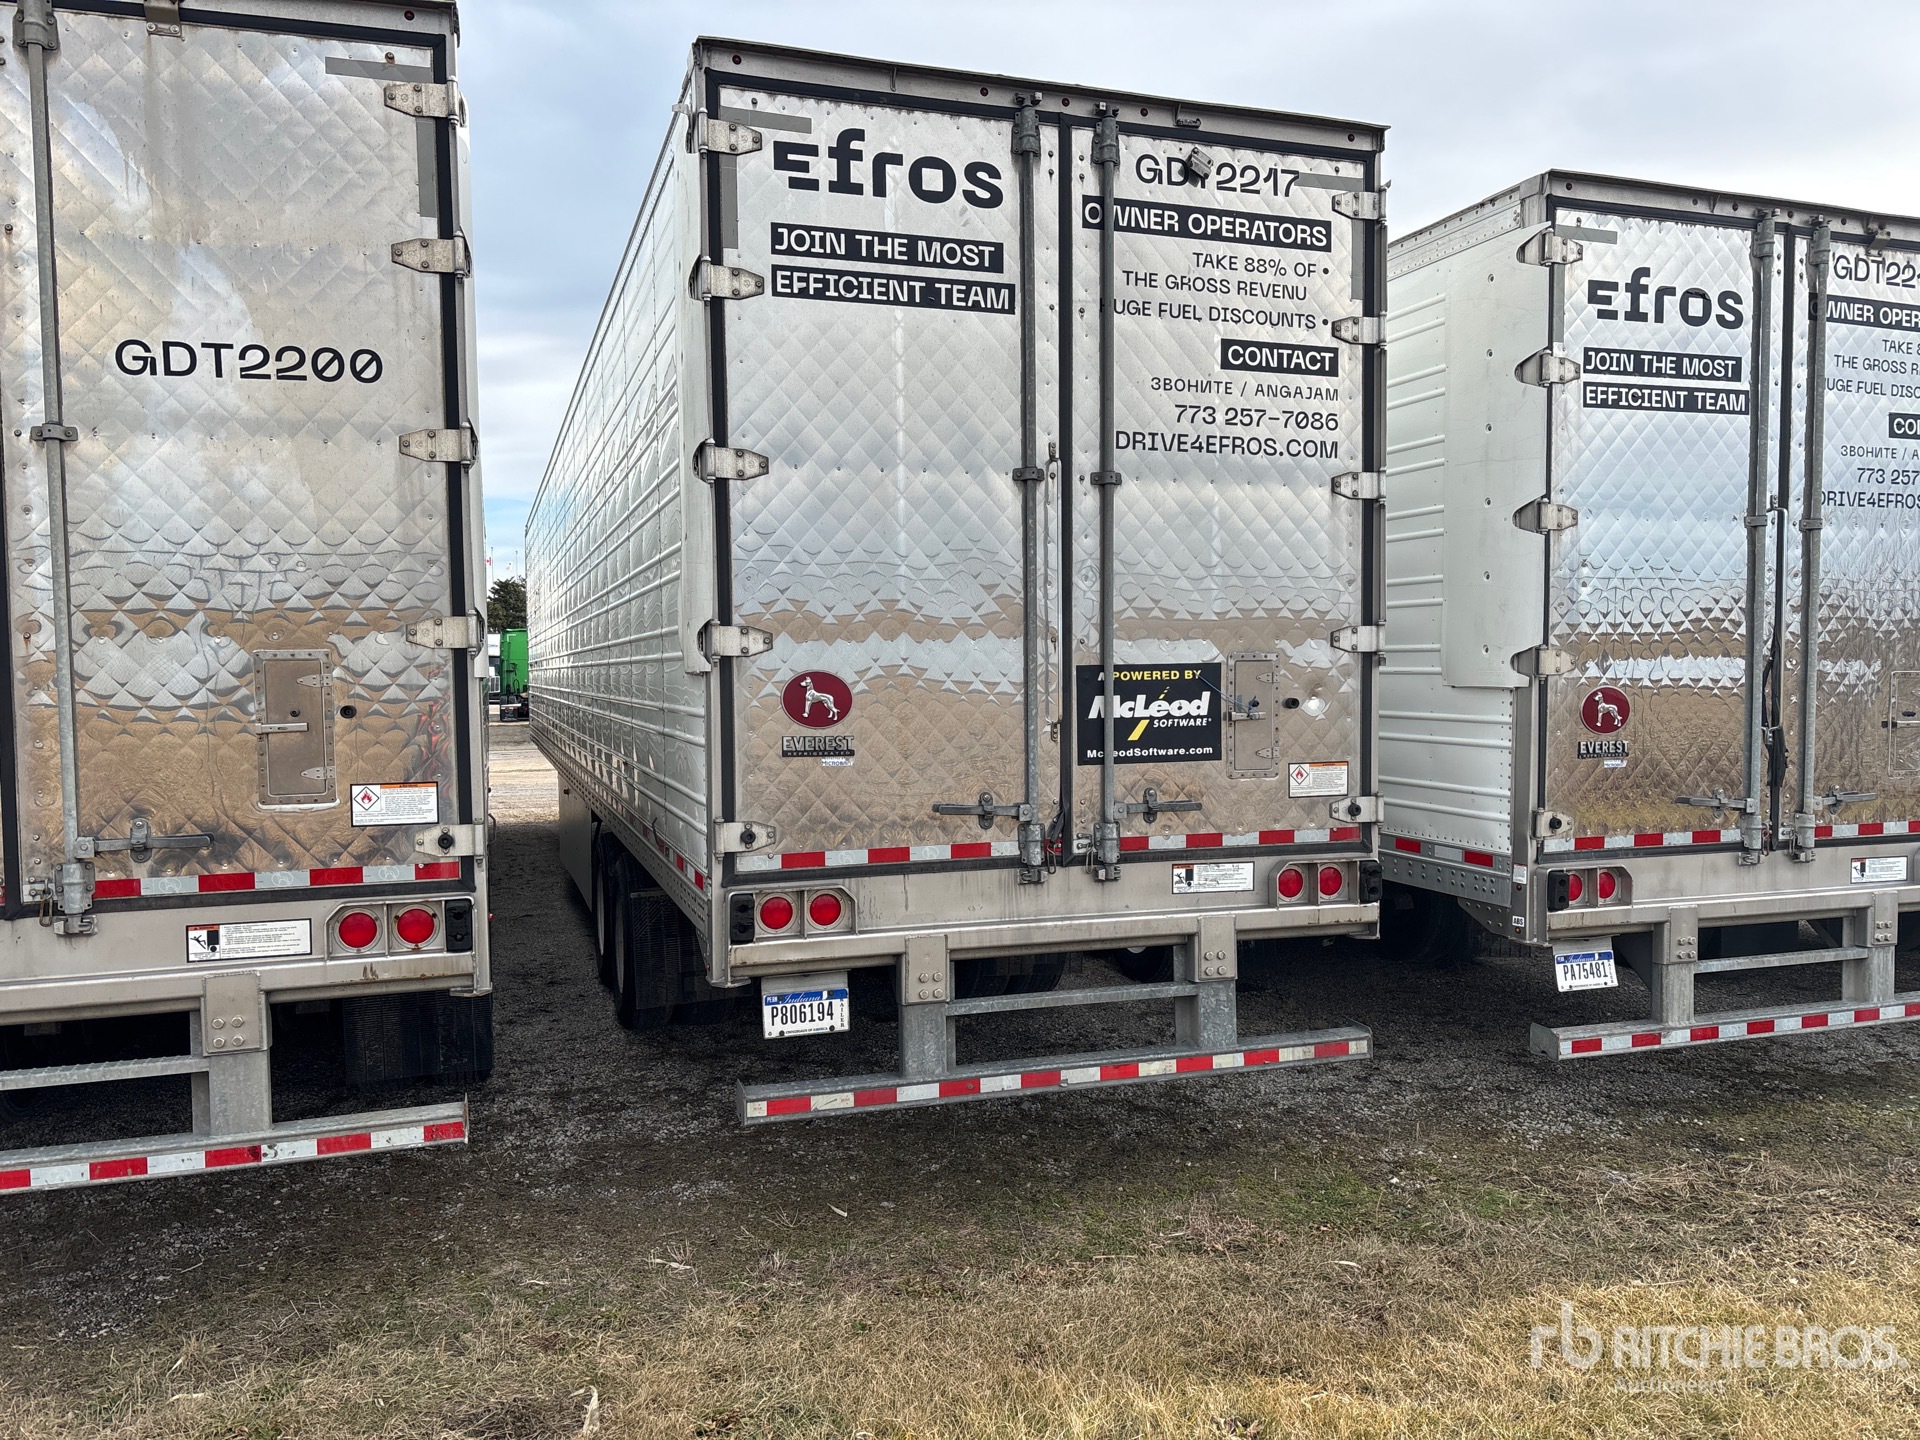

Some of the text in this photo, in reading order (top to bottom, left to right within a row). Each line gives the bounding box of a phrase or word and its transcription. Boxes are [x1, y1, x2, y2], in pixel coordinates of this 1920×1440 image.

[773, 128, 1004, 209] Efros
[1084, 202, 1328, 247] OWNER OPERATORS
[775, 227, 995, 267] JOIN THE MOST
[1192, 252, 1317, 278] TAKE 88% OF
[1833, 254, 1920, 289] GDT22
[776, 270, 1009, 310] EFFICIENT TEAM
[1122, 270, 1307, 301] THE GROSS REVENU
[1587, 266, 1744, 330] Efros
[1159, 302, 1202, 322] FUEL
[1209, 306, 1316, 330] DISCOUNTS
[1880, 306, 1920, 328] OPER
[1227, 345, 1334, 372] CONTACT
[1882, 339, 1913, 355] TAKE
[115, 339, 383, 384] GDT2200
[1585, 351, 1736, 378] JOIN THE MOST
[1834, 354, 1858, 370] THE
[1862, 357, 1907, 374] GROSS
[1255, 384, 1339, 401] ANGAJAM
[1585, 386, 1746, 412] EFFICIENT TEAM
[1825, 377, 1920, 399] UGE FUEL DISC
[1174, 404, 1339, 431] 773 257-7086
[1115, 430, 1339, 459] DRIVE4EFROS.COM
[1857, 467, 1920, 486] 773 257
[1113, 670, 1180, 681] POWERED
[1184, 669, 1201, 680] BY
[1088, 691, 1211, 719] McLeod
[782, 735, 854, 751] EVEREST
[1087, 747, 1213, 758] MceodSoftware.com
[1580, 740, 1629, 754] EVEREST
[1563, 961, 1608, 981] PA75481
[783, 992, 821, 1004] Indiana
[771, 1001, 834, 1026] P806194
